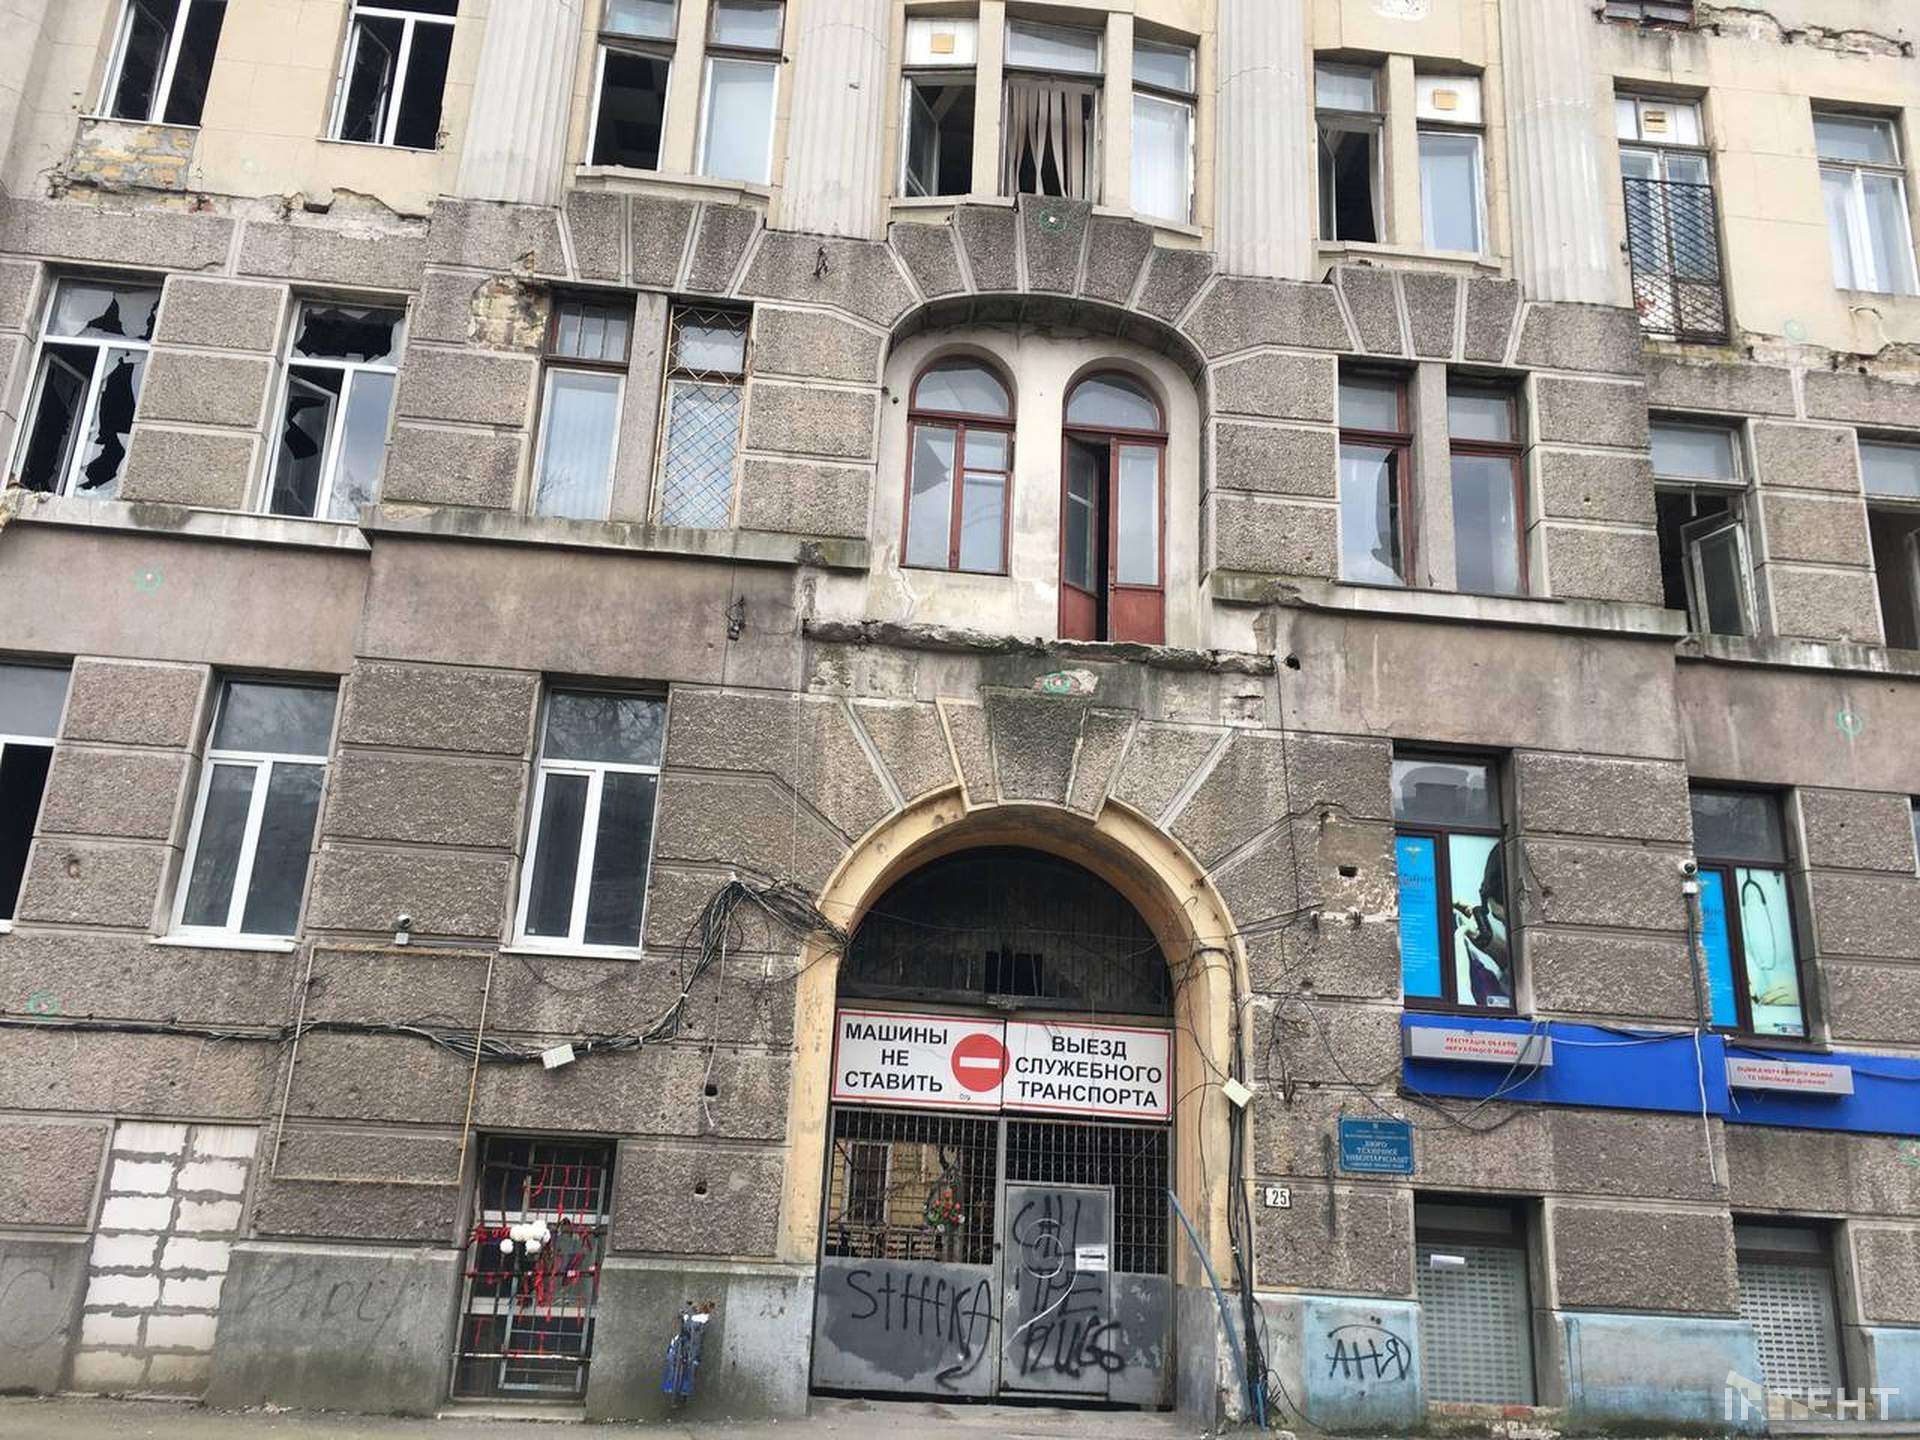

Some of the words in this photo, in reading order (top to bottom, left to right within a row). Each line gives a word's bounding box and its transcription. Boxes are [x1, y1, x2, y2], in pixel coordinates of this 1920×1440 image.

[845, 1022, 948, 1045] МАШИНЫ
[881, 1049, 909, 1067] НЕ
[1051, 1035, 1128, 1060] ВЫЕЗД
[845, 1070, 943, 1093] СТАВИТЬ
[1015, 1056, 1162, 1084] СЛУЖЕБНОГО
[1017, 1080, 1158, 1107] ТРАНСПОРТА
[1272, 1189, 1287, 1205] 25
